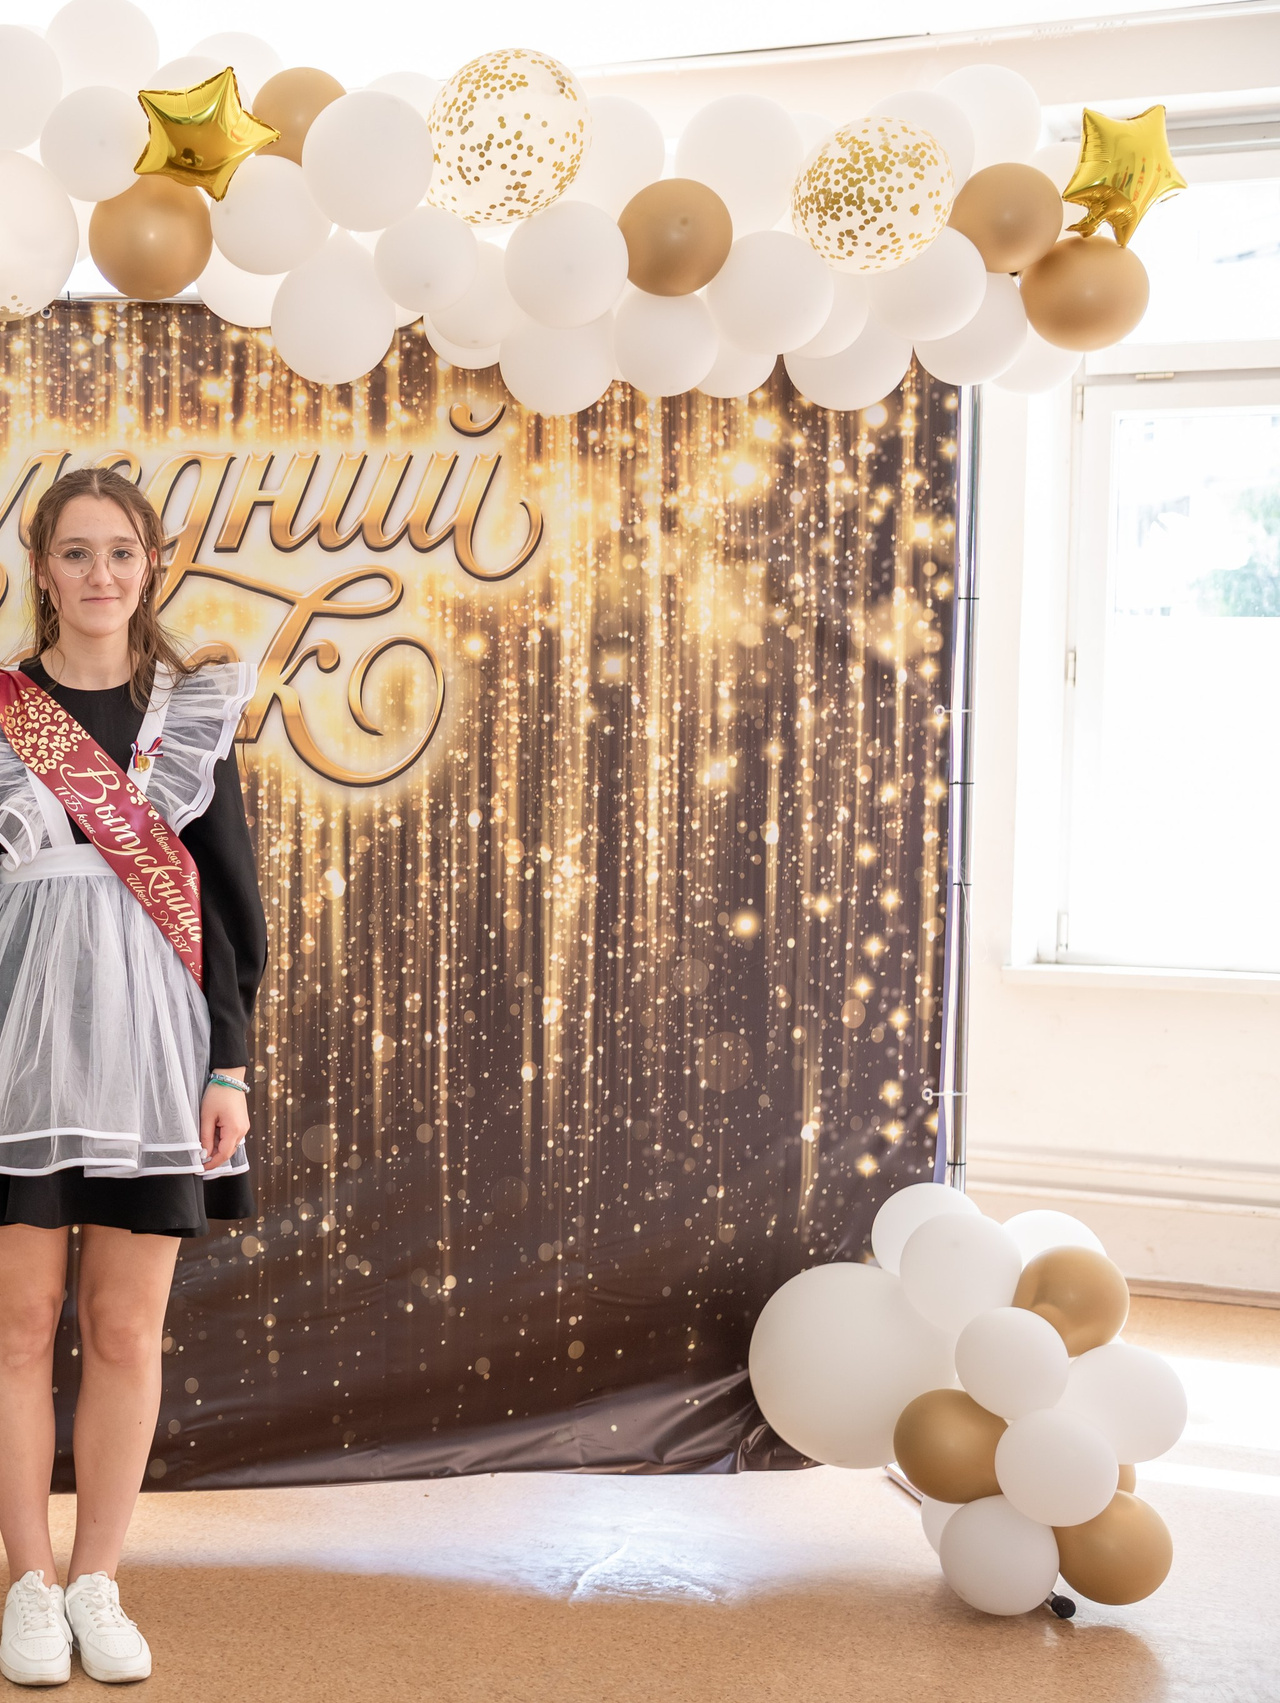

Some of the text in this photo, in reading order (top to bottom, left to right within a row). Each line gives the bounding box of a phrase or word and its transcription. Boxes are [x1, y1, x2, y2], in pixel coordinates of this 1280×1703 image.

[76, 812, 96, 834] класс
[60, 750, 202, 944] Выпускница
[126, 872, 153, 907] Школа
